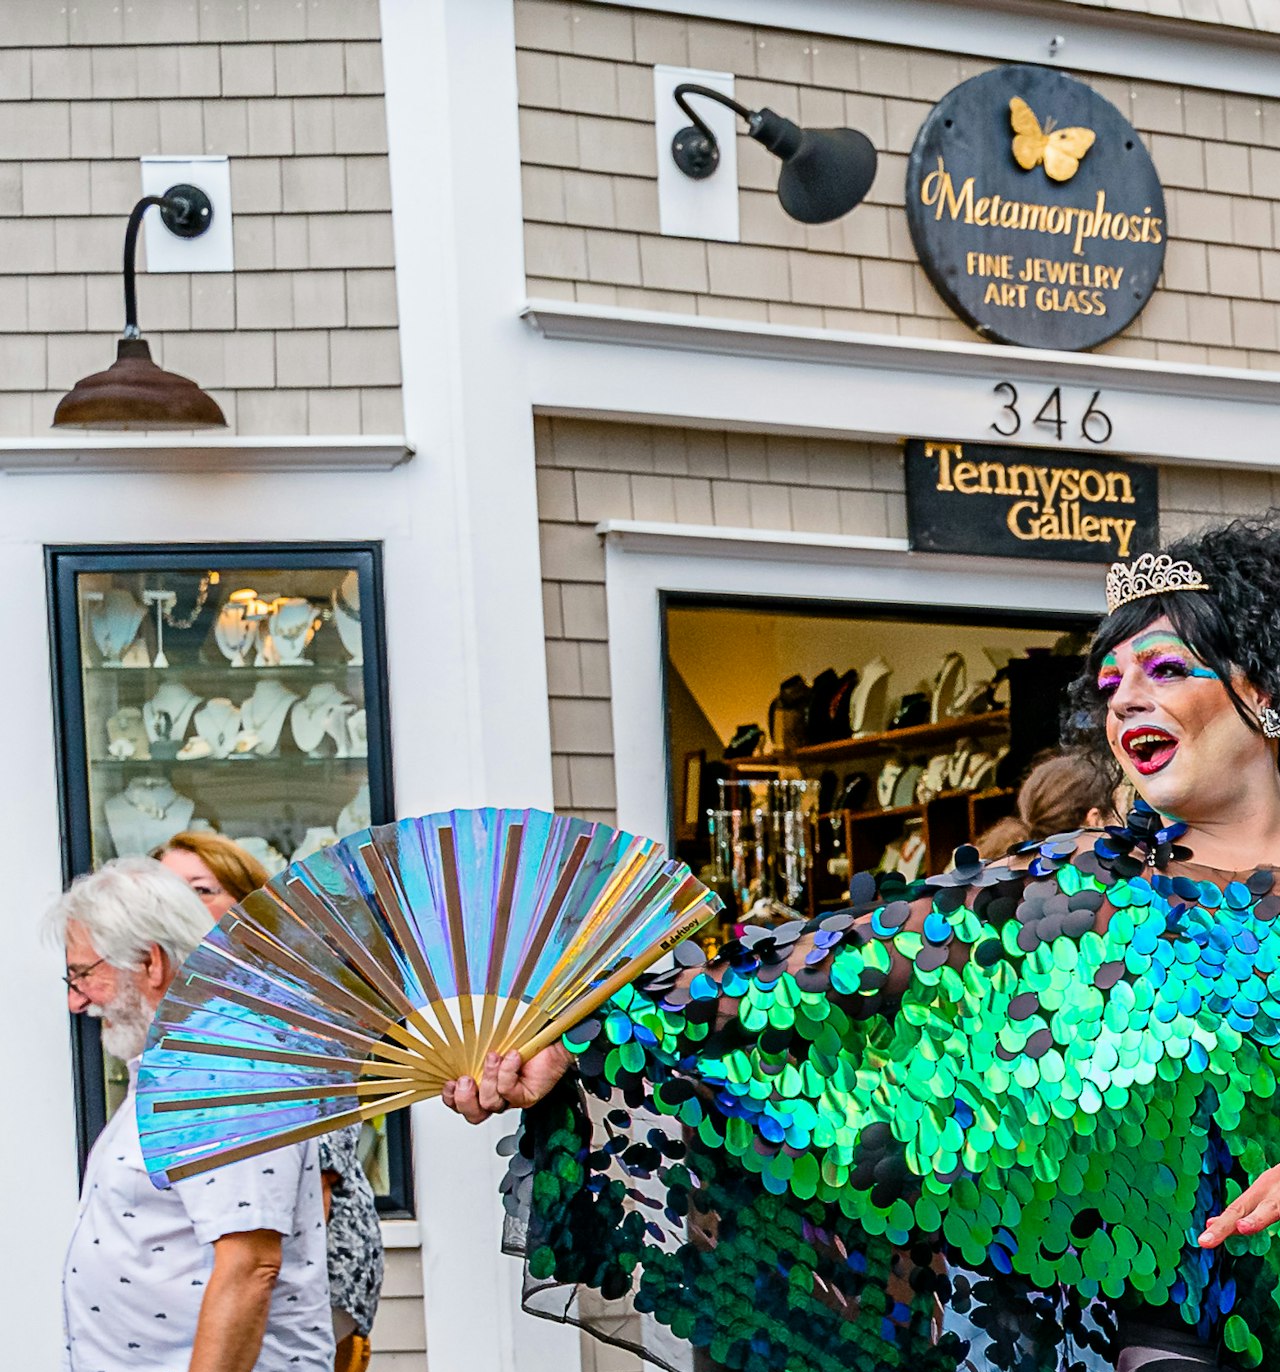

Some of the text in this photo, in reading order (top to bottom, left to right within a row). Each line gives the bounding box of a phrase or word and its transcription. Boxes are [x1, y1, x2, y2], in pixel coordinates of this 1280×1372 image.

[921, 157, 1162, 255] Metamorphosis
[966, 251, 1124, 290] FINE JEWELRY
[983, 282, 1107, 316] ART GLASS
[990, 382, 1113, 445] 346
[925, 442, 1135, 515] Tennyson
[1006, 501, 1136, 558] Gallery
